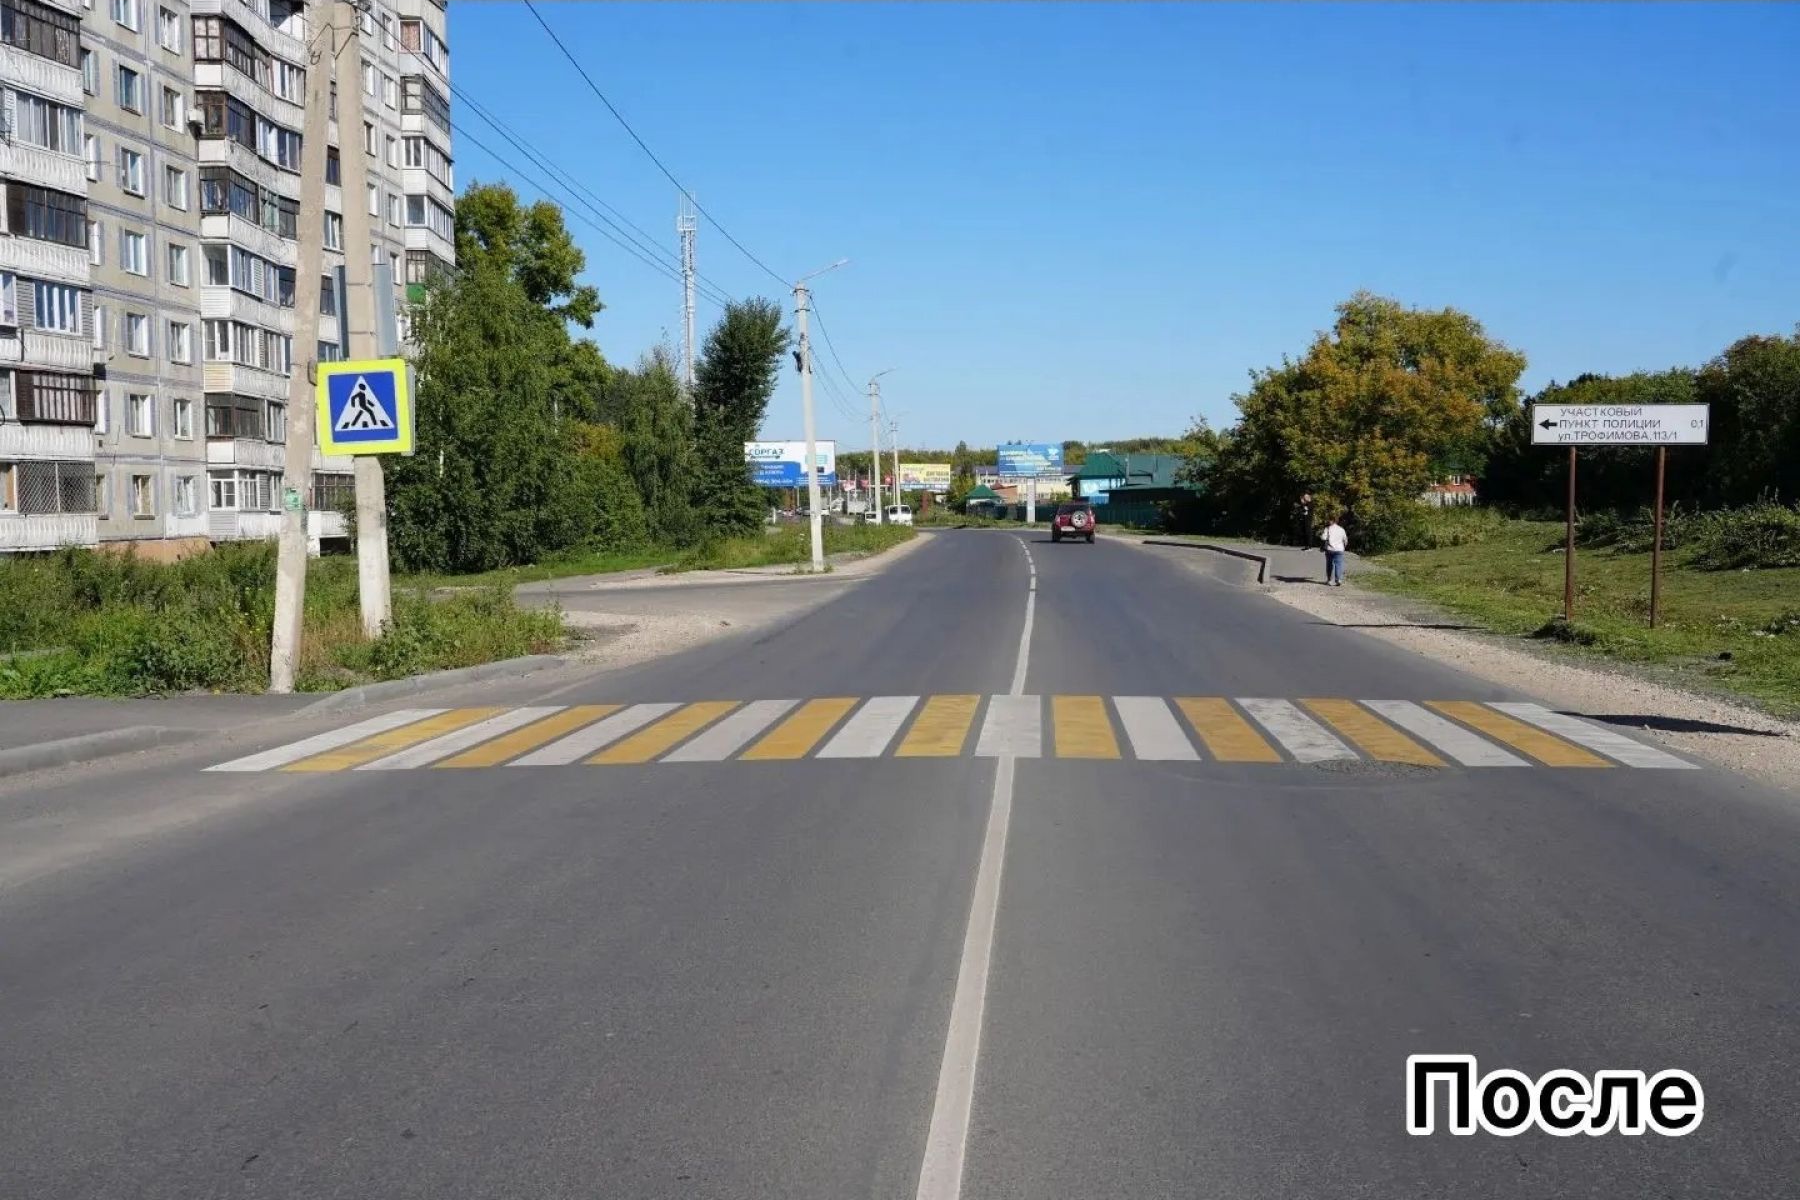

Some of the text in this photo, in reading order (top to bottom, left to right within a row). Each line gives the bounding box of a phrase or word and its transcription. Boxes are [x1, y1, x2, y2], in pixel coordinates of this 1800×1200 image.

[1560, 406, 1642, 417] УЧАСТКОВЫЙ
[1559, 419, 1599, 429] ПУНКТ
[1603, 419, 1661, 430] ПОЛИЦИИ
